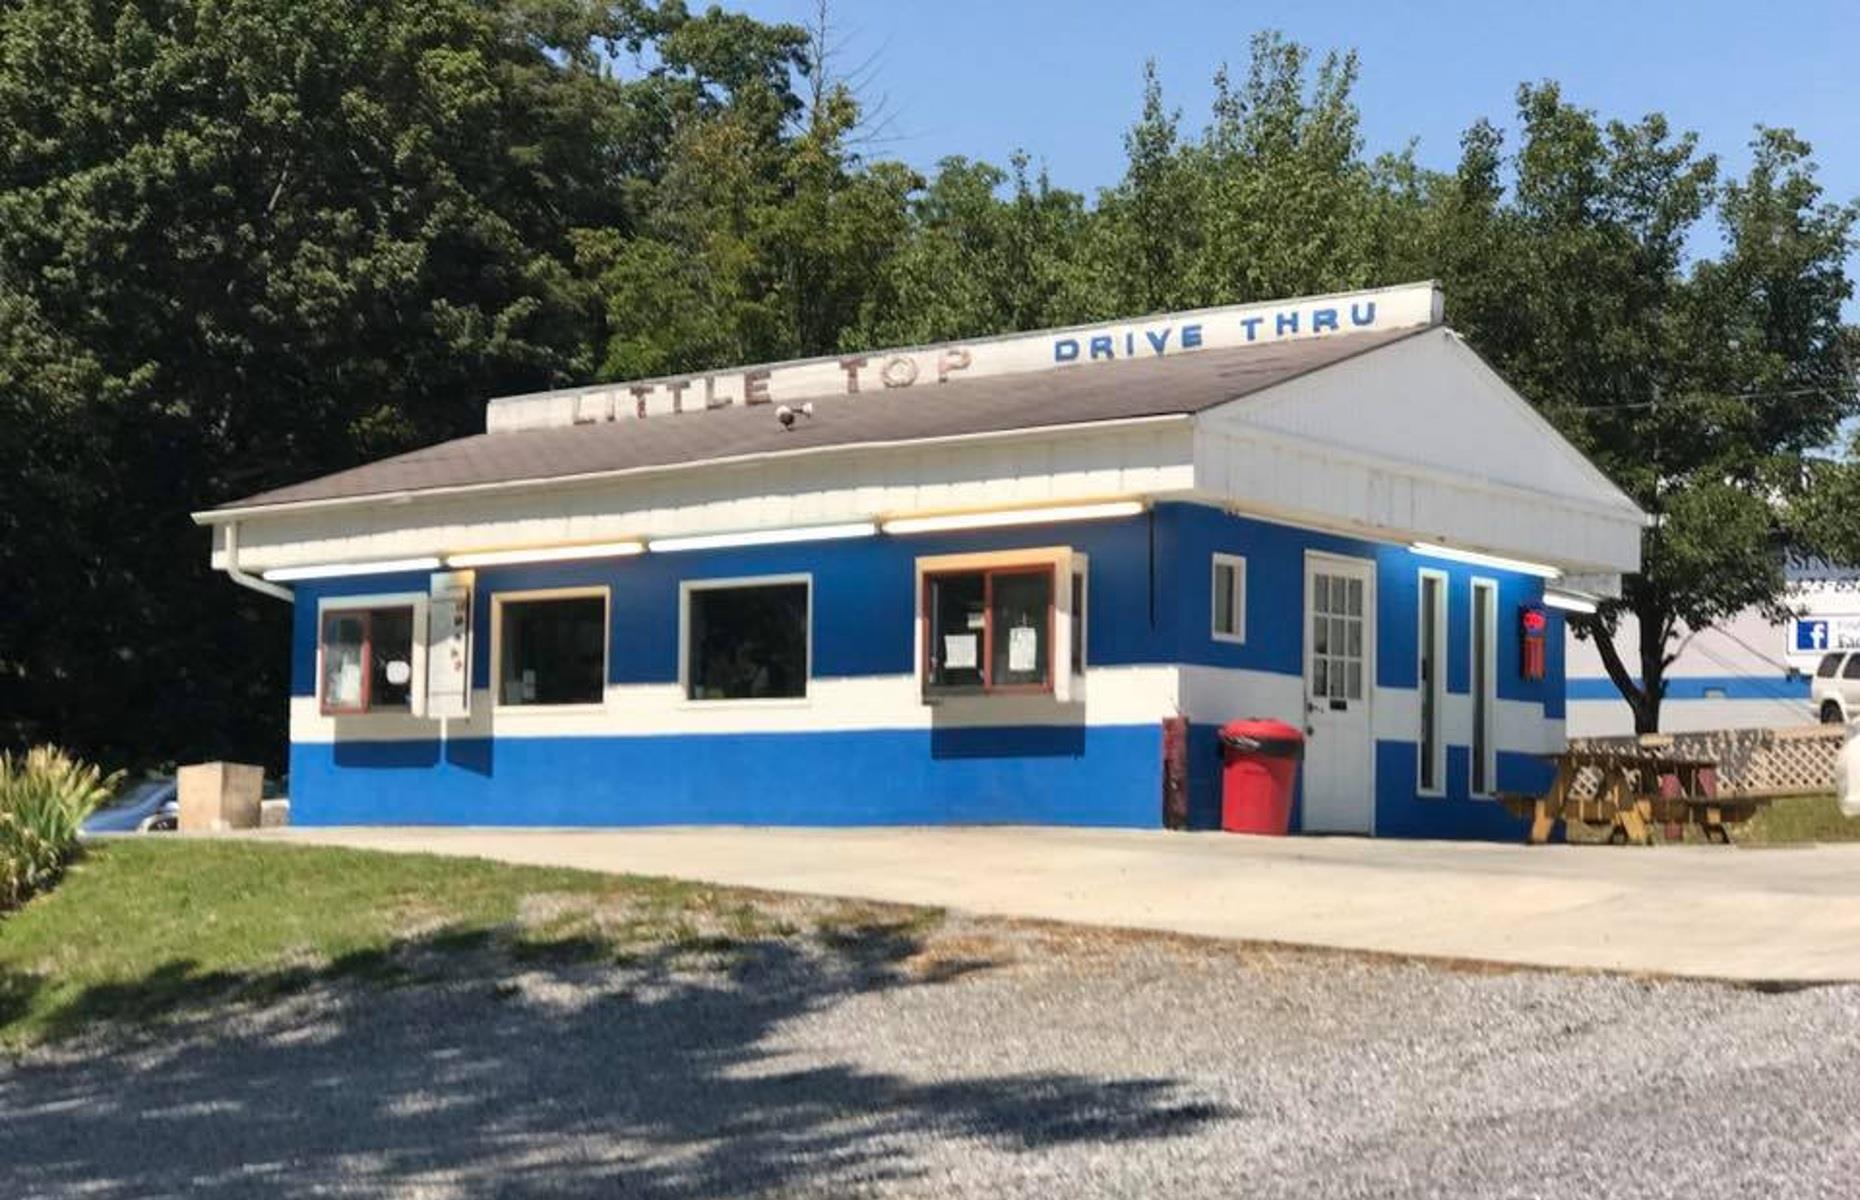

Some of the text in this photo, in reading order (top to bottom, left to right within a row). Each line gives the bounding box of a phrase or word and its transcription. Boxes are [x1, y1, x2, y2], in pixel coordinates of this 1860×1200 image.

[573, 302, 1376, 424] LITTLE TOP DRIVE THRU
